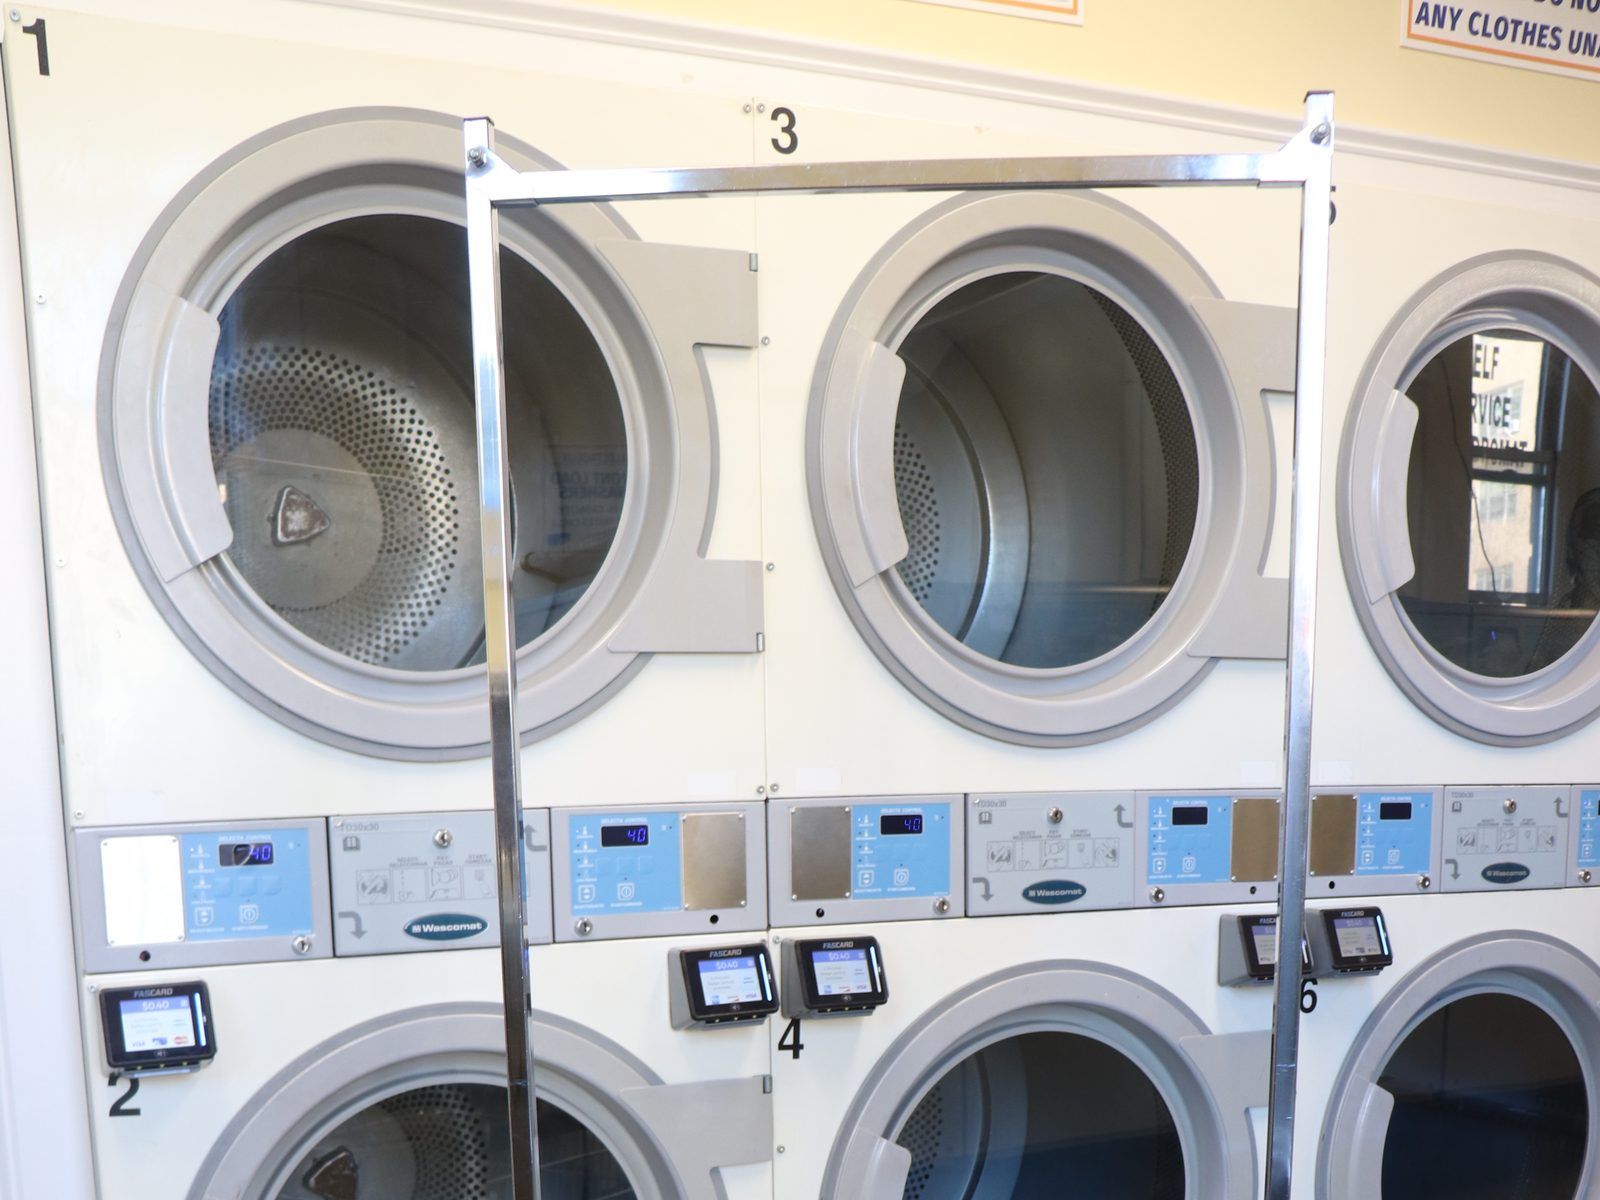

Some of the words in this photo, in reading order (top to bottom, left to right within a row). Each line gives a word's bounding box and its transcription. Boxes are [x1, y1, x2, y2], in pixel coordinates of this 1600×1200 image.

[1415, 1, 1463, 31] ANY
[1468, 11, 1563, 51] CLOTHES
[1568, 30, 1600, 58] UN
[22, 18, 50, 76] 1
[770, 106, 798, 155] 3
[904, 818, 921, 831] 40
[627, 827, 647, 842] 40
[1036, 888, 1083, 897] Wascomat
[422, 922, 483, 933] Wascomat
[823, 941, 854, 949] FASCARD
[709, 949, 742, 958] FASCARD
[134, 988, 174, 998] FASCARD
[1300, 978, 1318, 1014] 6
[778, 1016, 804, 1059] 4
[108, 1071, 141, 1117] 2
